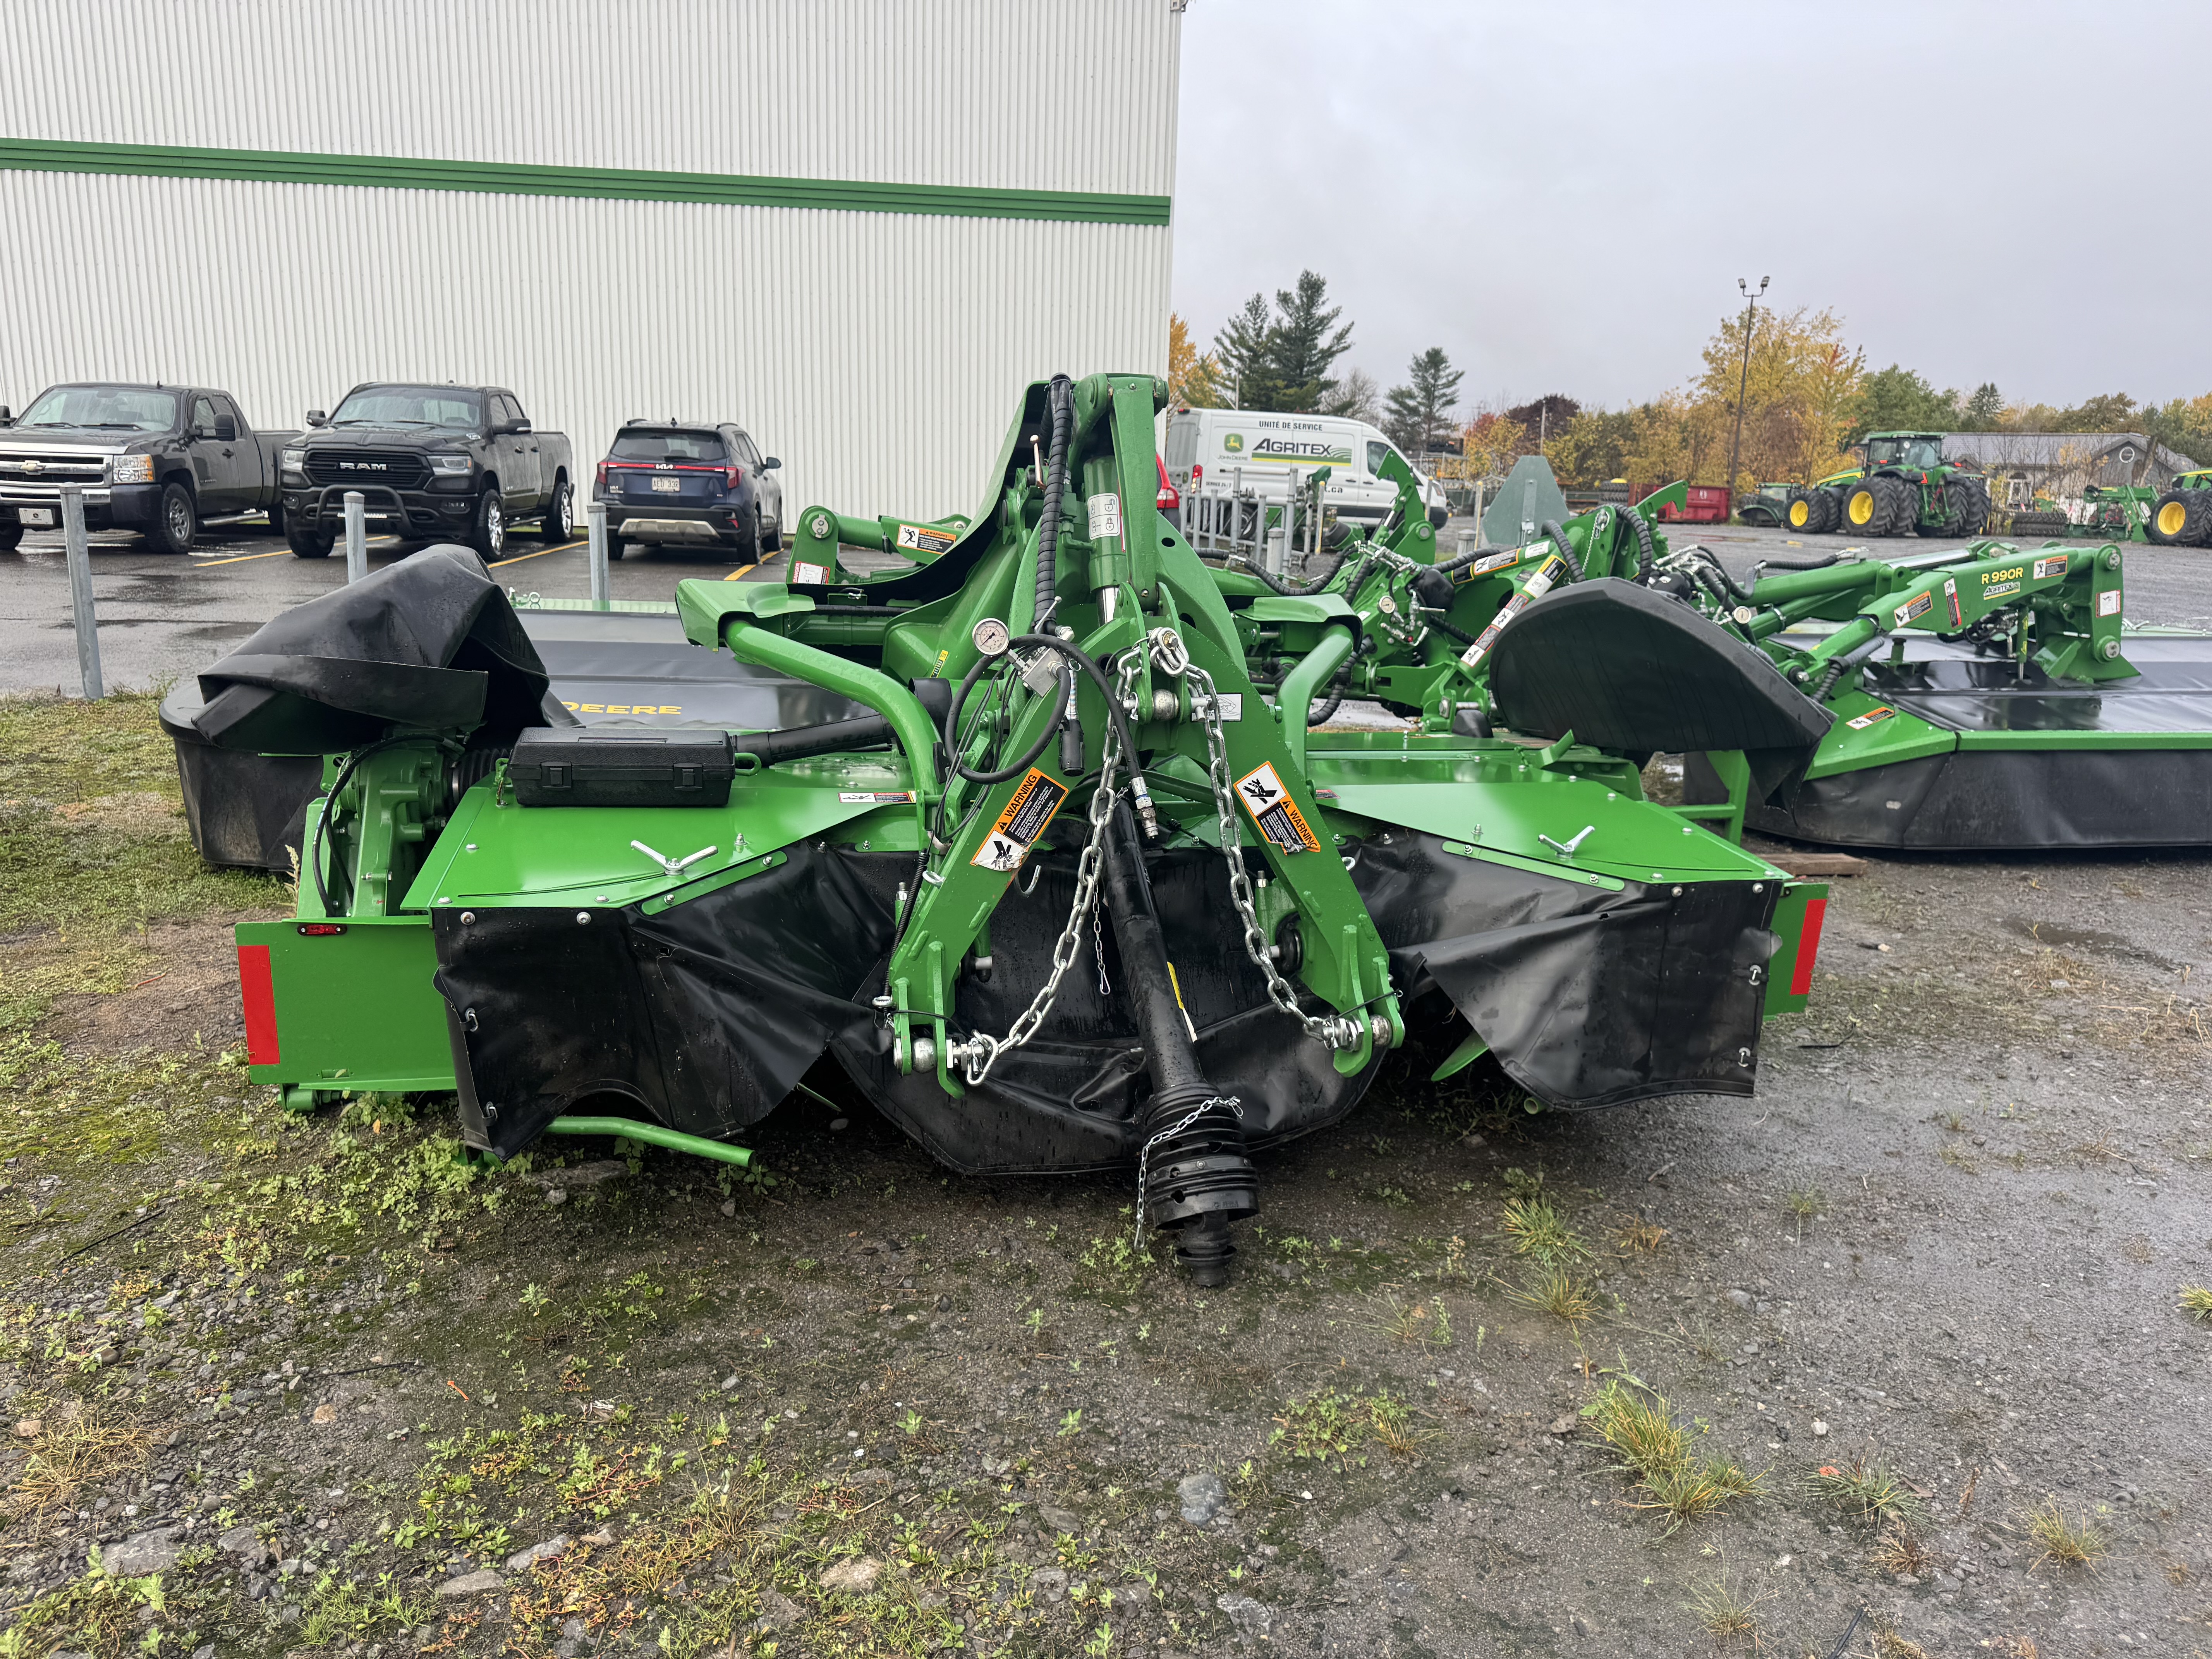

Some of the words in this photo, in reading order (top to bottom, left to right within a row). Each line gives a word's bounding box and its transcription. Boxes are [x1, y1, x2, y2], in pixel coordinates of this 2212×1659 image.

[1253, 438, 1332, 455] AGRITEX
[792, 563, 800, 583] DANGER
[1982, 573, 1989, 585] R
[1991, 567, 2023, 583] 990R
[1005, 775, 1037, 817] WARNING
